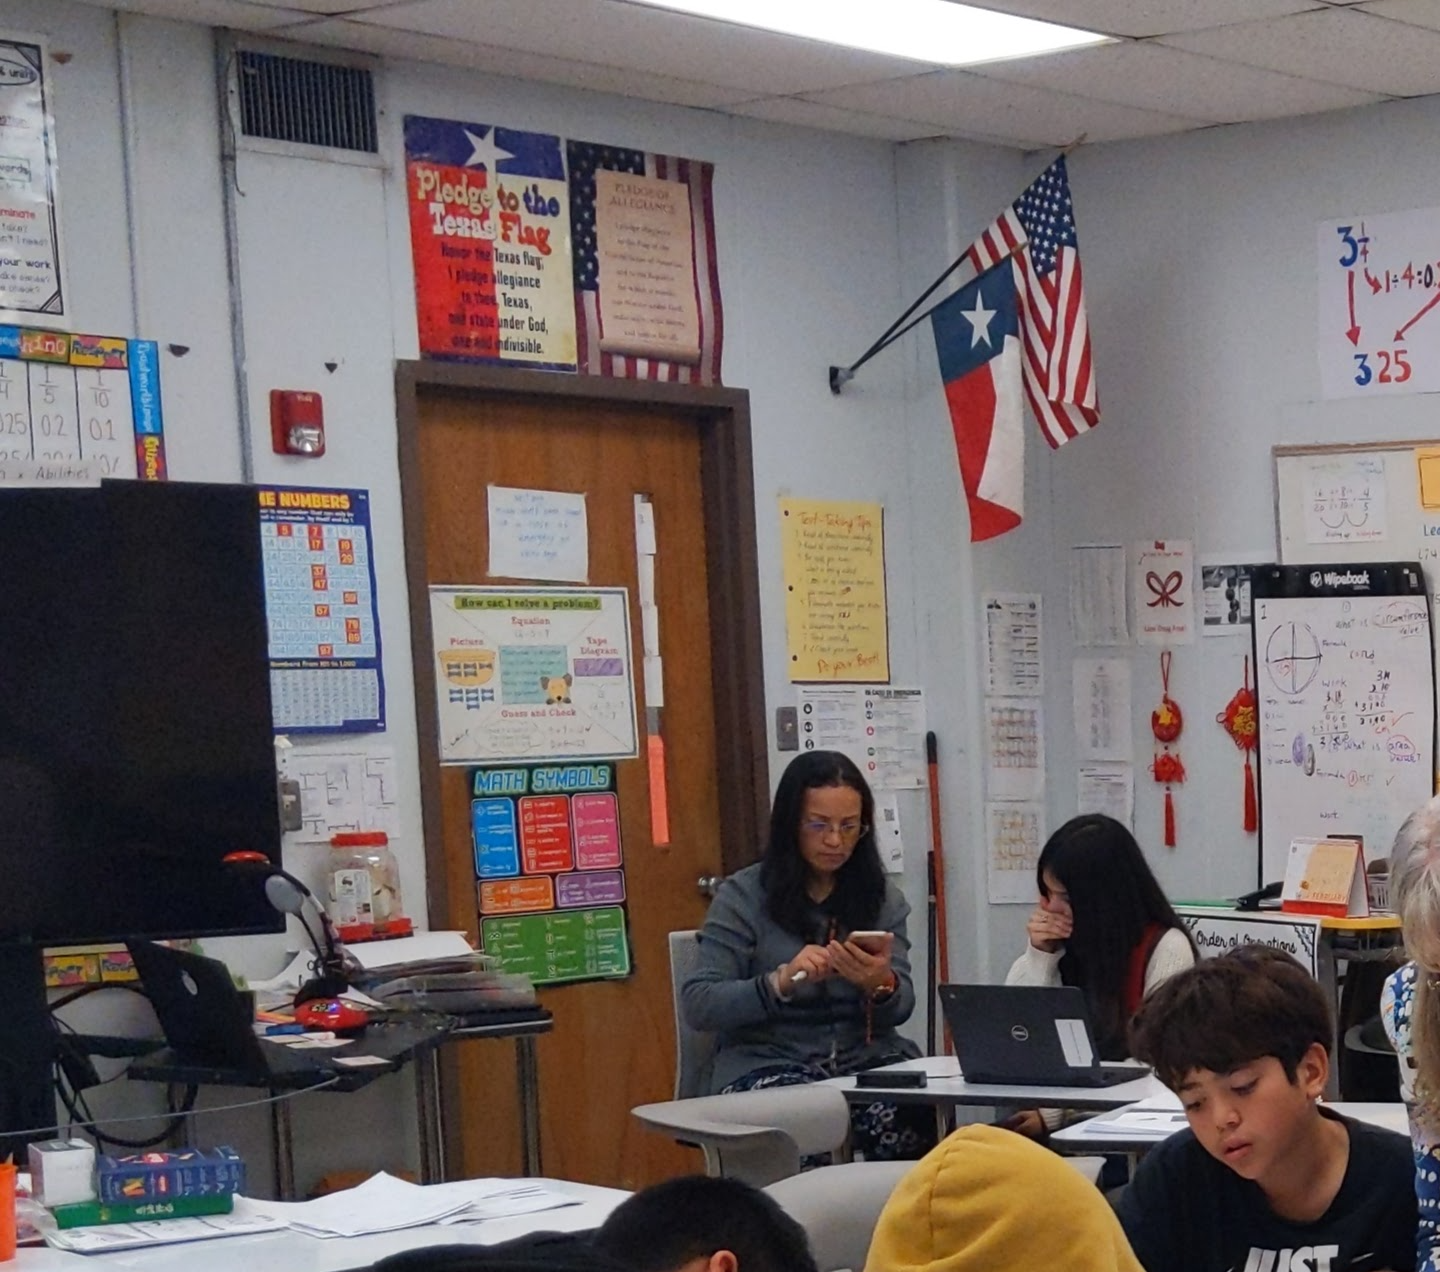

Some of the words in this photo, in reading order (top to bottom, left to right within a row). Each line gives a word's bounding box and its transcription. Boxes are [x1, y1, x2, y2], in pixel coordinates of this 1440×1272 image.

[416, 167, 493, 215] Pledge
[497, 183, 519, 211] to
[523, 183, 560, 217] the
[615, 183, 655, 197] PLEDGE
[657, 190, 670, 200] OF
[609, 197, 676, 215] ALLEGIANCE
[429, 202, 497, 240] Texas
[499, 211, 552, 256] Flag
[26, 258, 51, 269] work
[494, 248, 521, 265] Texas
[456, 268, 488, 286] pledge
[492, 270, 541, 290] allegiance
[502, 292, 533, 312] Texas,
[497, 316, 524, 330] under
[528, 316, 548, 335] God,
[43, 388, 55, 404] 5
[93, 391, 109, 408] 10
[36, 465, 89, 480] Abilities
[280, 491, 350, 510] NUMBERS
[281, 527, 288, 536] 5
[312, 527, 318, 536] 7
[312, 539, 321, 550] 17
[313, 566, 326, 577] 37
[1324, 570, 1370, 588] Wipebook
[314, 578, 327, 589] 47
[461, 598, 484, 608] How
[486, 600, 504, 608] can
[515, 599, 541, 608] solve
[552, 599, 599, 610] problem?
[511, 617, 551, 627] Equation
[450, 638, 484, 646] Picture
[586, 637, 608, 647] Tape
[580, 646, 618, 656] Diagram
[501, 710, 528, 718] Guess
[531, 709, 547, 718] and
[549, 709, 577, 718] Check
[1387, 742, 1411, 751] area
[477, 770, 526, 793] MATH
[533, 766, 609, 791] SYMBOLS
[1196, 929, 1228, 949] Order
